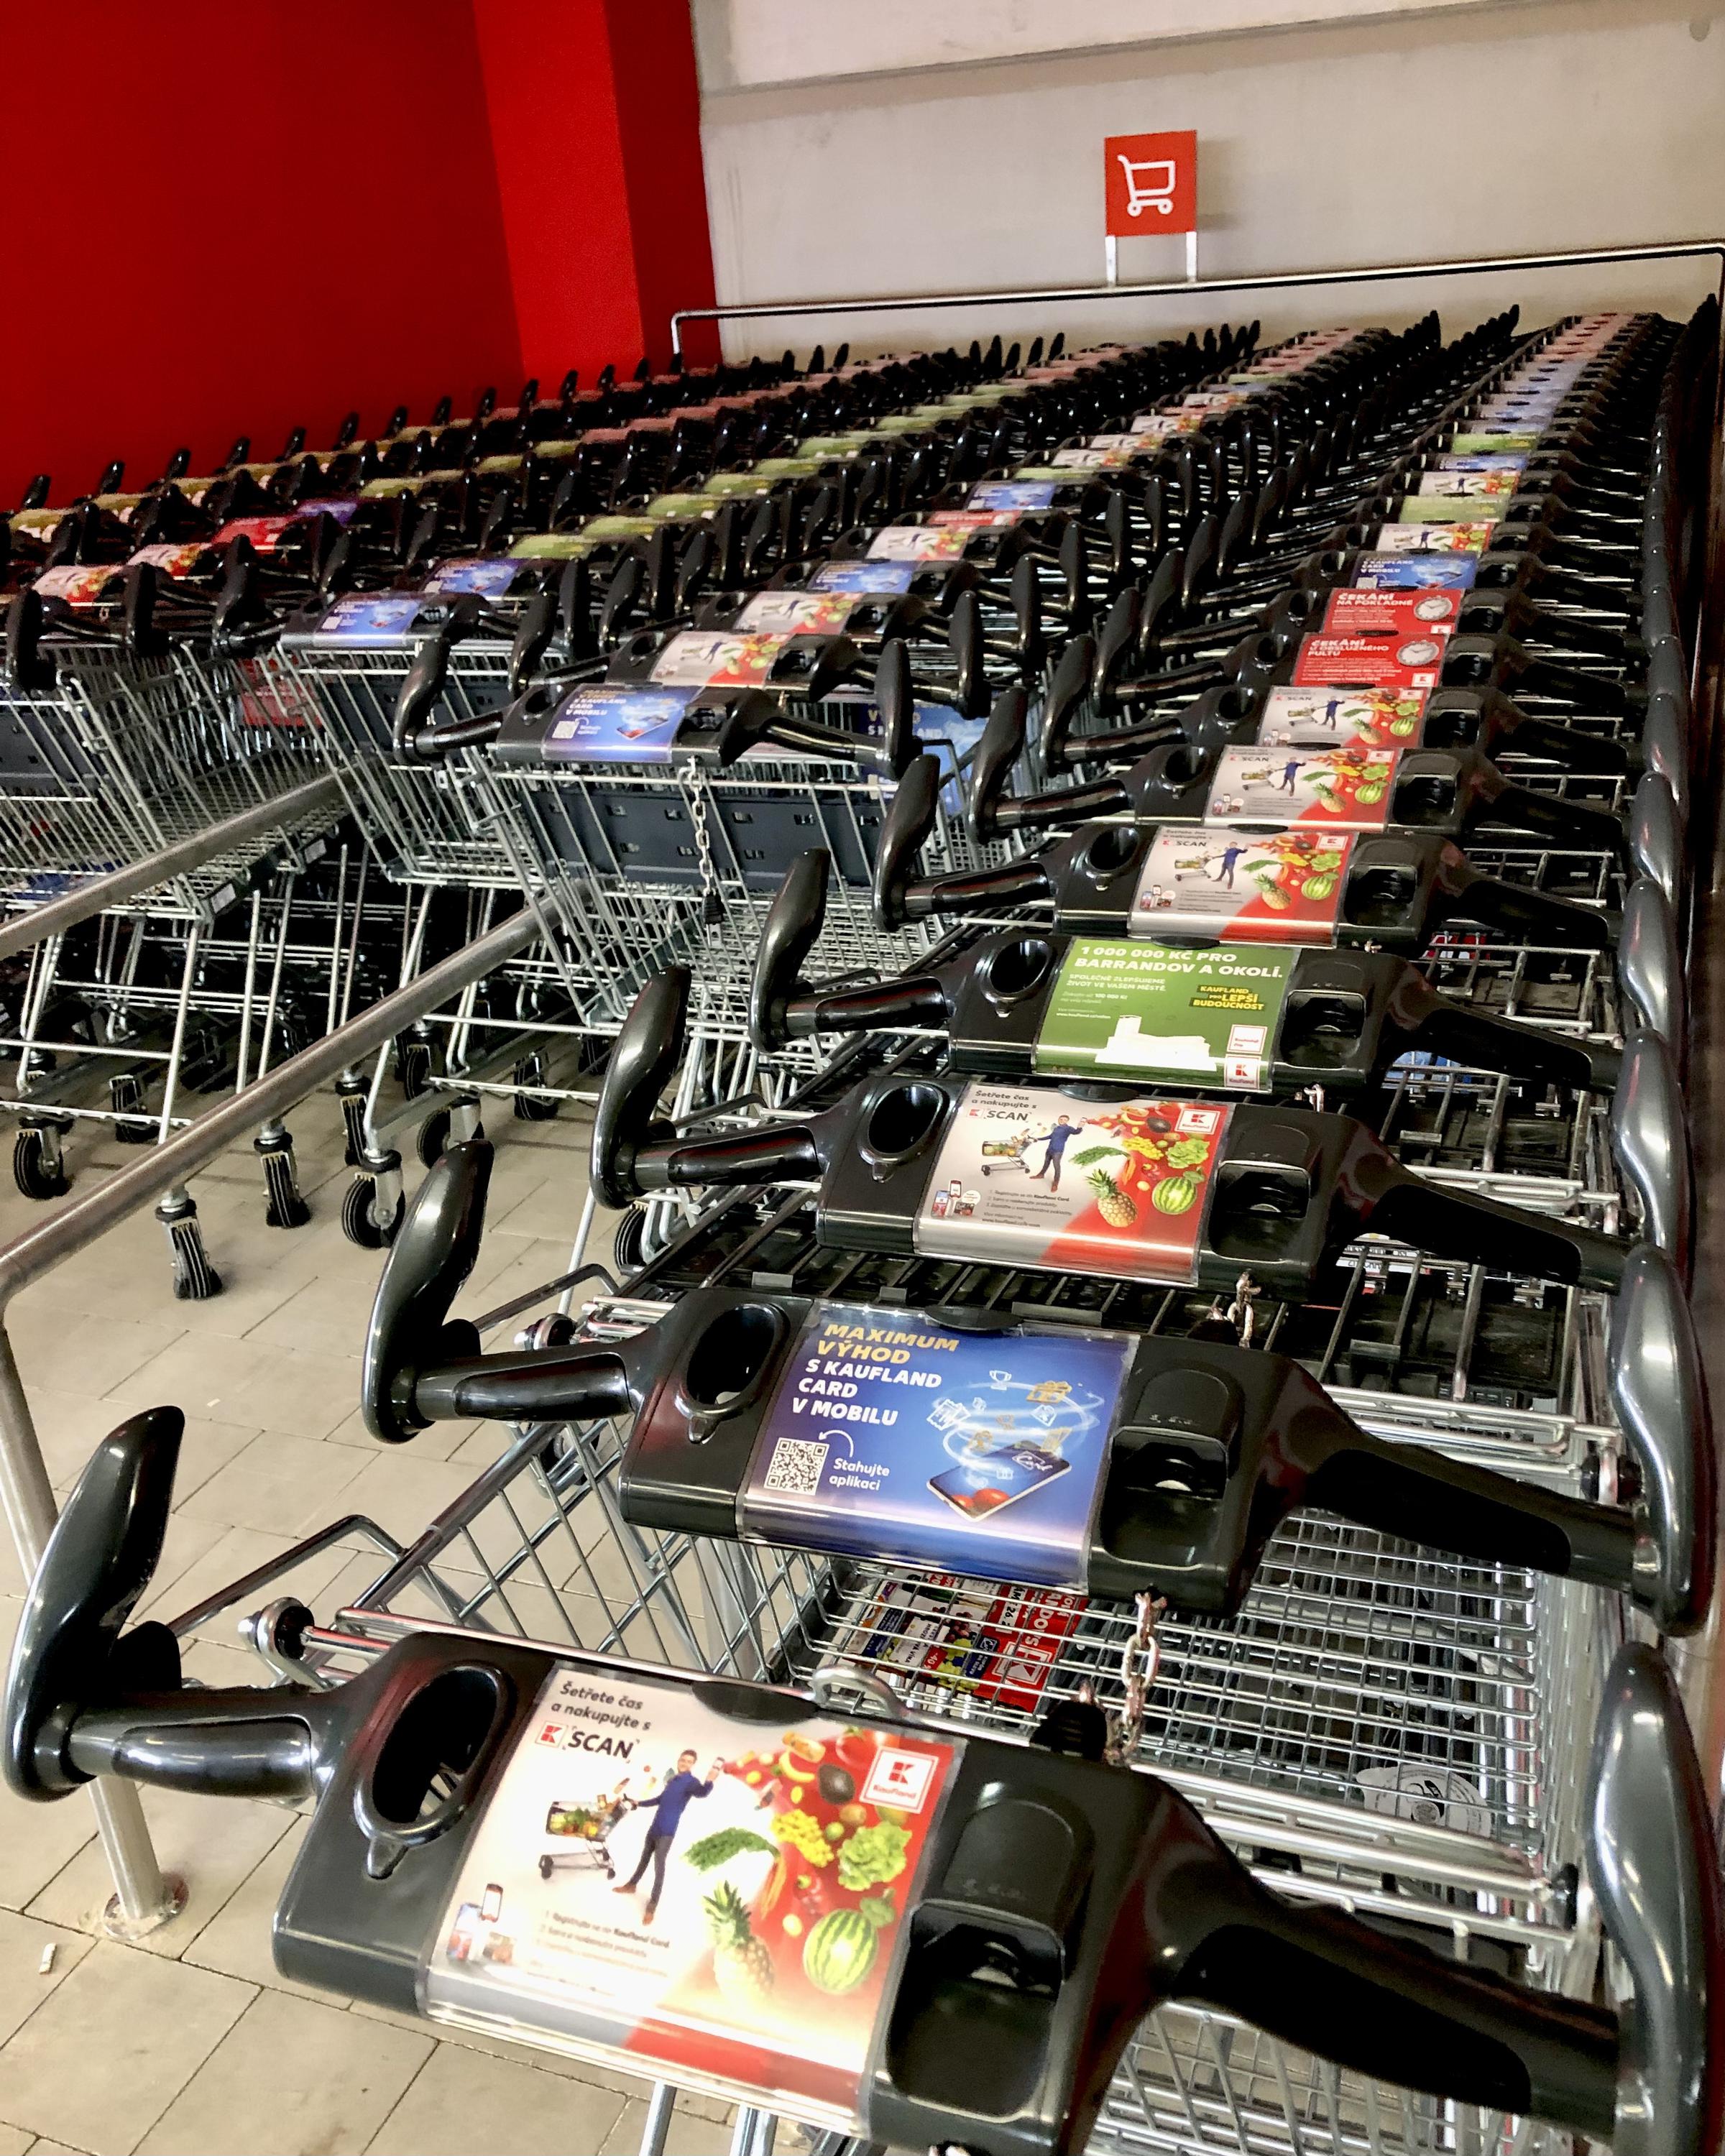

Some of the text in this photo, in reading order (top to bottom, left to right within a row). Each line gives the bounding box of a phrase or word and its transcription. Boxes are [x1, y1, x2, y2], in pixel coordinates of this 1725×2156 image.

[1093, 947, 1127, 957] 000
[1131, 949, 1164, 958] 000
[1196, 952, 1237, 962] PRO
[1075, 958, 1195, 973] BARRANDOV
[1198, 964, 1213, 974] A
[1193, 1000, 1265, 1010] BUDOUCNOST
[980, 1100, 1029, 1108] nakupujte
[987, 1110, 1029, 1121] SCAN
[824, 1324, 960, 1352] MAXIMUM
[817, 1340, 911, 1364] VÝHOD
[806, 1359, 942, 1388] S KAUFLAND
[799, 1378, 858, 1399] CARD
[792, 1397, 898, 1426] V MOBILU
[834, 1457, 890, 1478] Stahujte
[829, 1475, 880, 1491] aplikaci
[560, 1680, 643, 1710] Šetřete čas
[551, 1703, 651, 1731] a nakupujte s
[568, 1731, 634, 1759] SCAN
